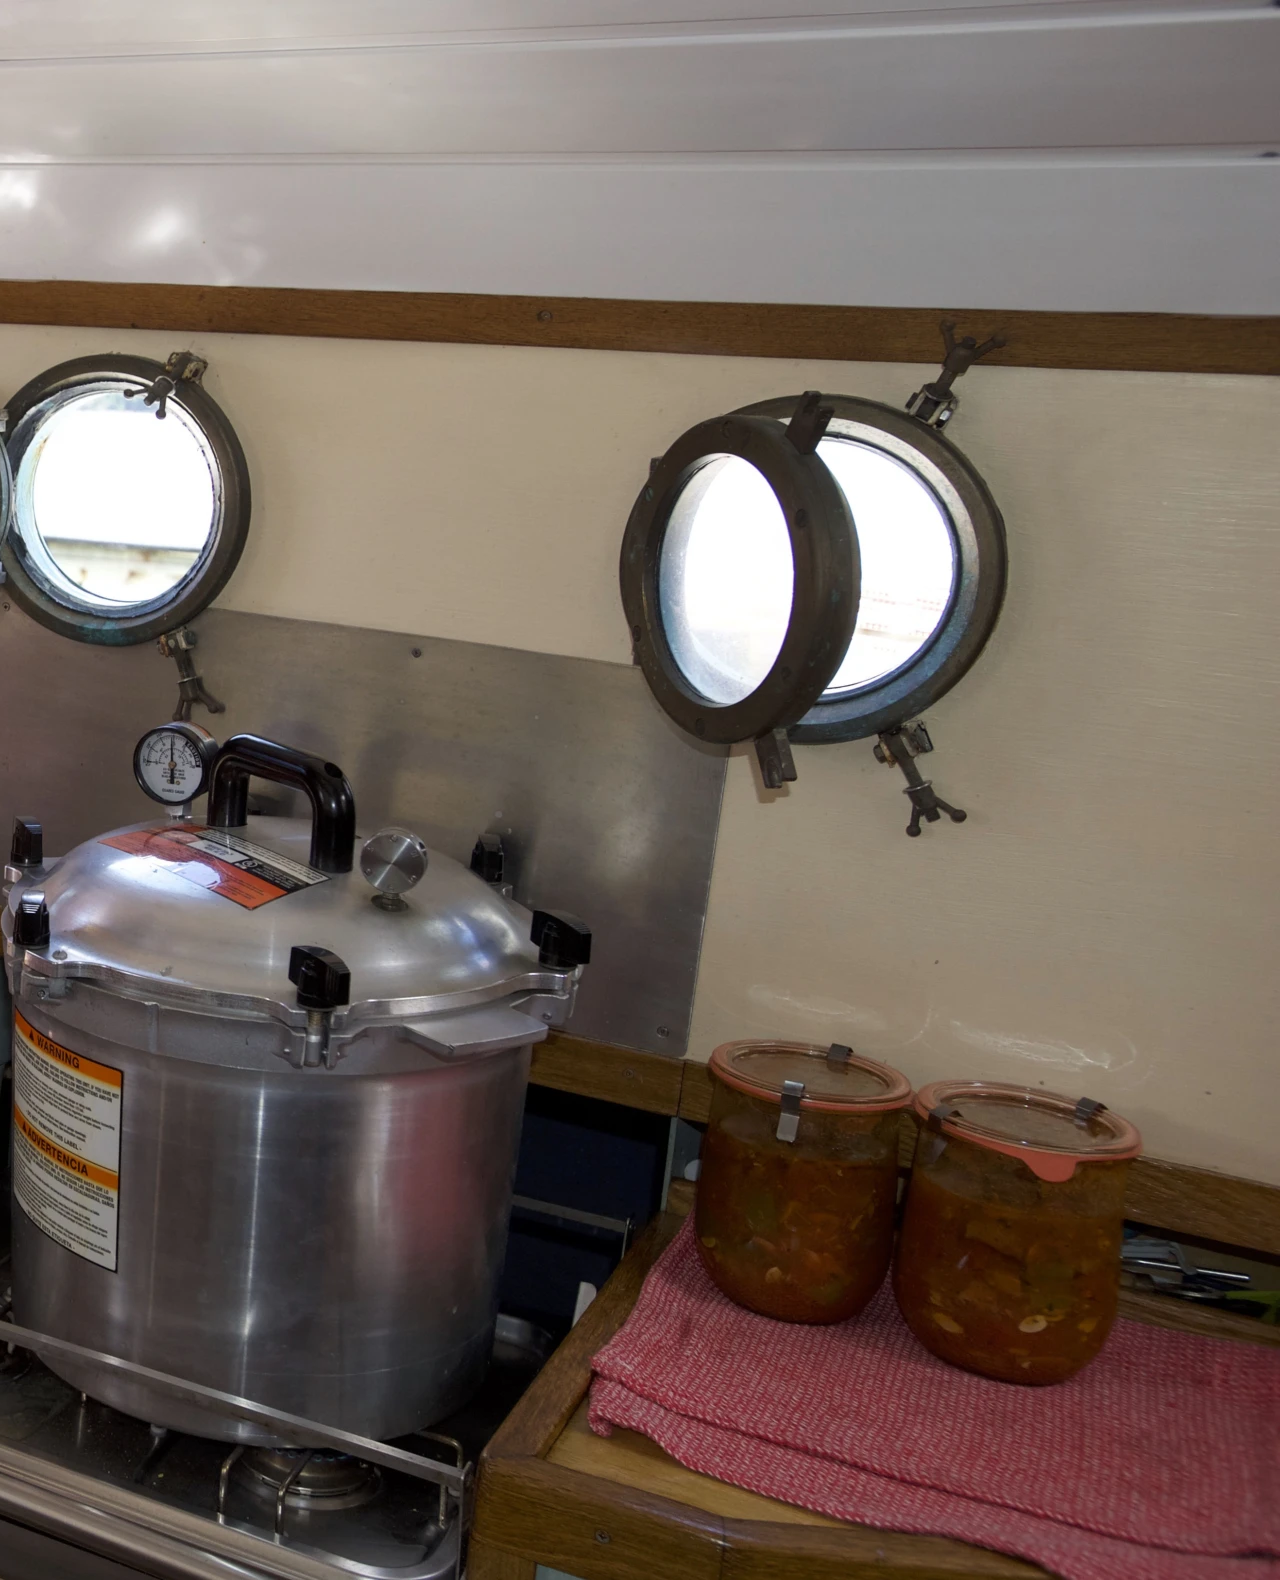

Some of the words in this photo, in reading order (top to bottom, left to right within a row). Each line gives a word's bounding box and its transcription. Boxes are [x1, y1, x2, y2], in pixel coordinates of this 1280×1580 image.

[37, 1035, 80, 1069] WARNING
[38, 1120, 53, 1135] REMOVE
[54, 1131, 63, 1142] THIS
[64, 1138, 79, 1150] LABEL
[28, 1127, 88, 1176] ADVERTENCIA
[52, 1231, 72, 1249] ETIQUETA
